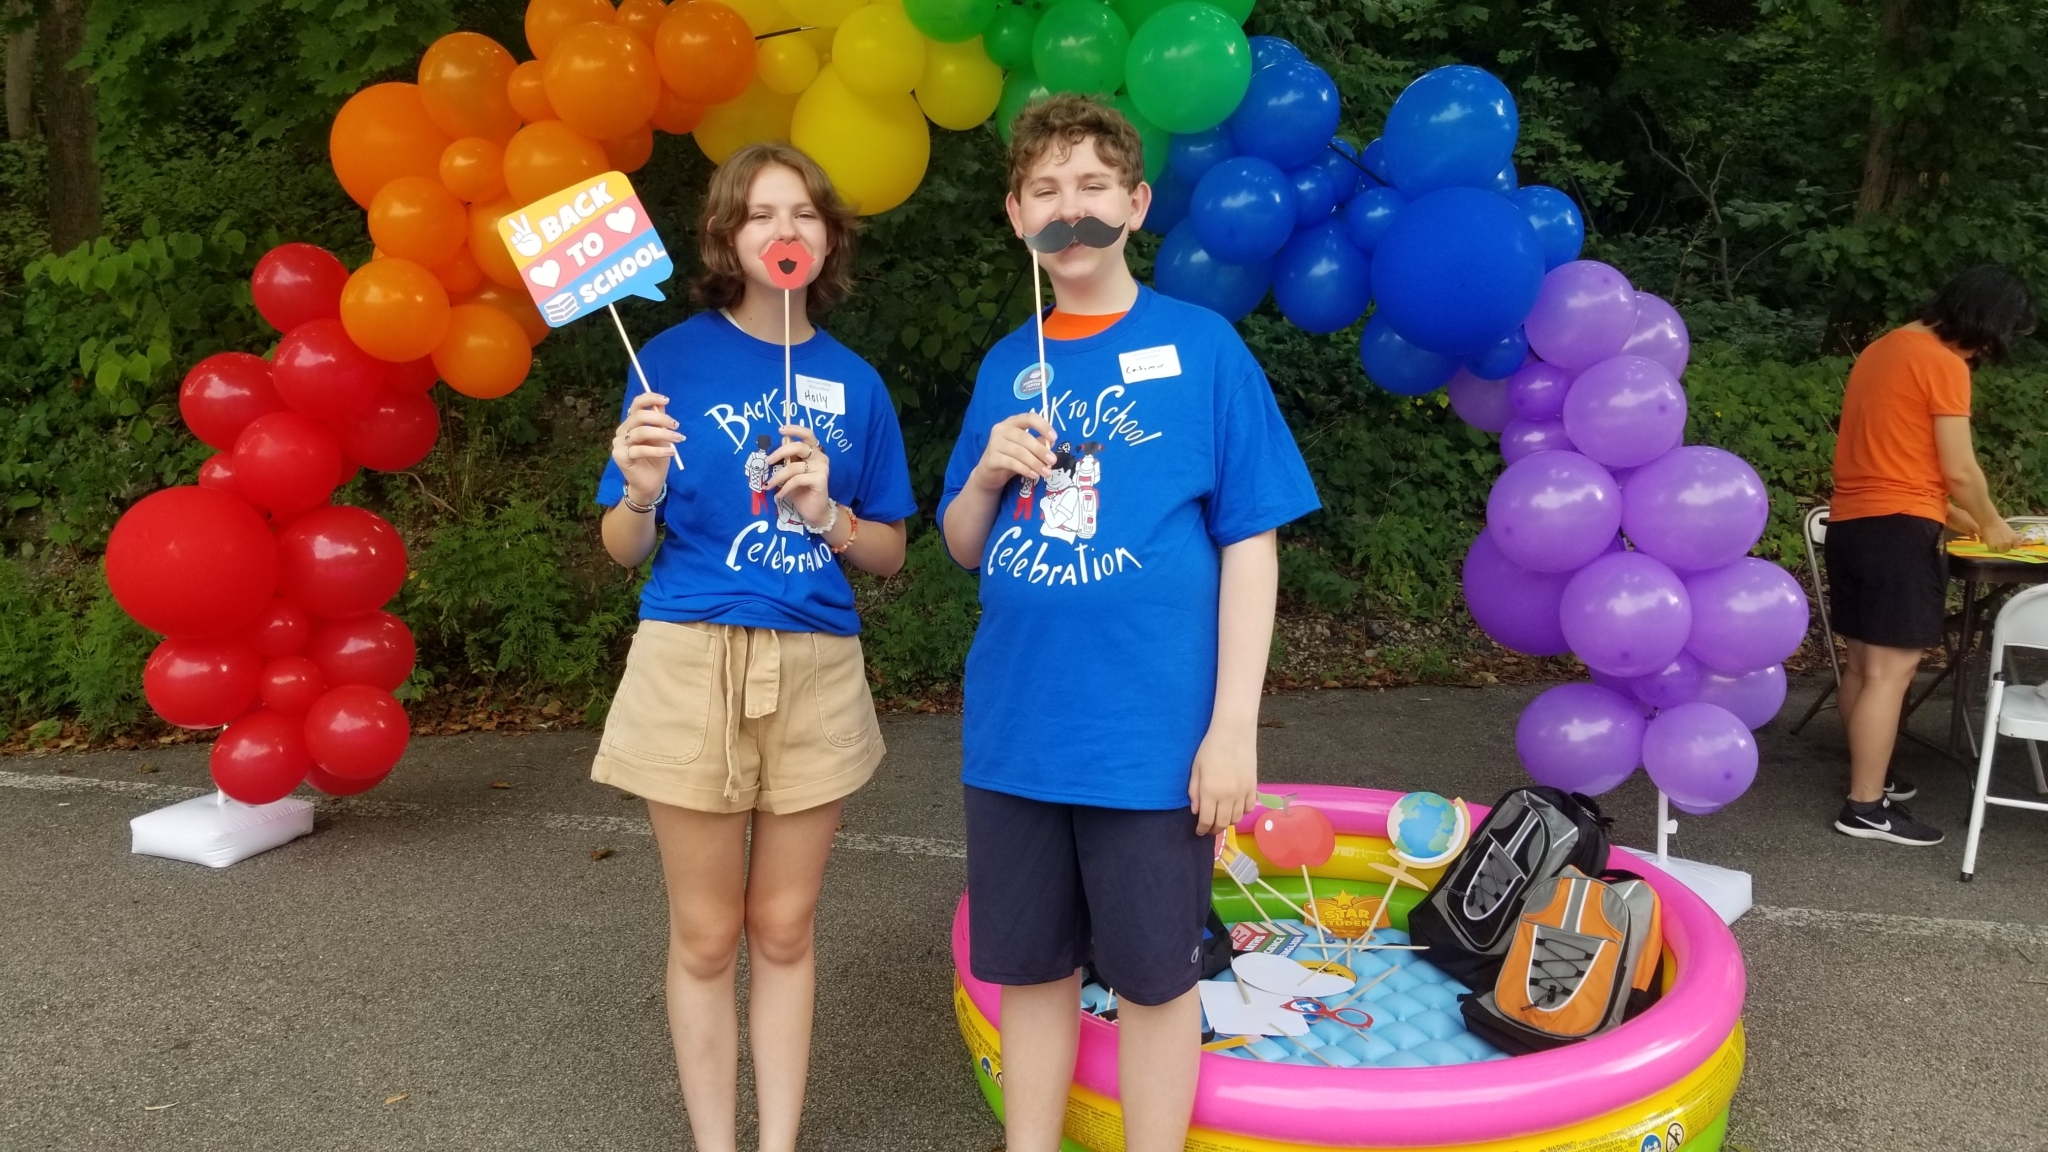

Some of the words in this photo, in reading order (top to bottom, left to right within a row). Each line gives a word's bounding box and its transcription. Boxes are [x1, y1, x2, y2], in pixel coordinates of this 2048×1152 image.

[538, 181, 615, 243] BACK
[566, 231, 605, 268] TO
[578, 242, 666, 304] SCHOOL
[804, 389, 828, 410] Holly
[1322, 908, 1370, 919] STAR
[1263, 936, 1286, 954] CIENCE
